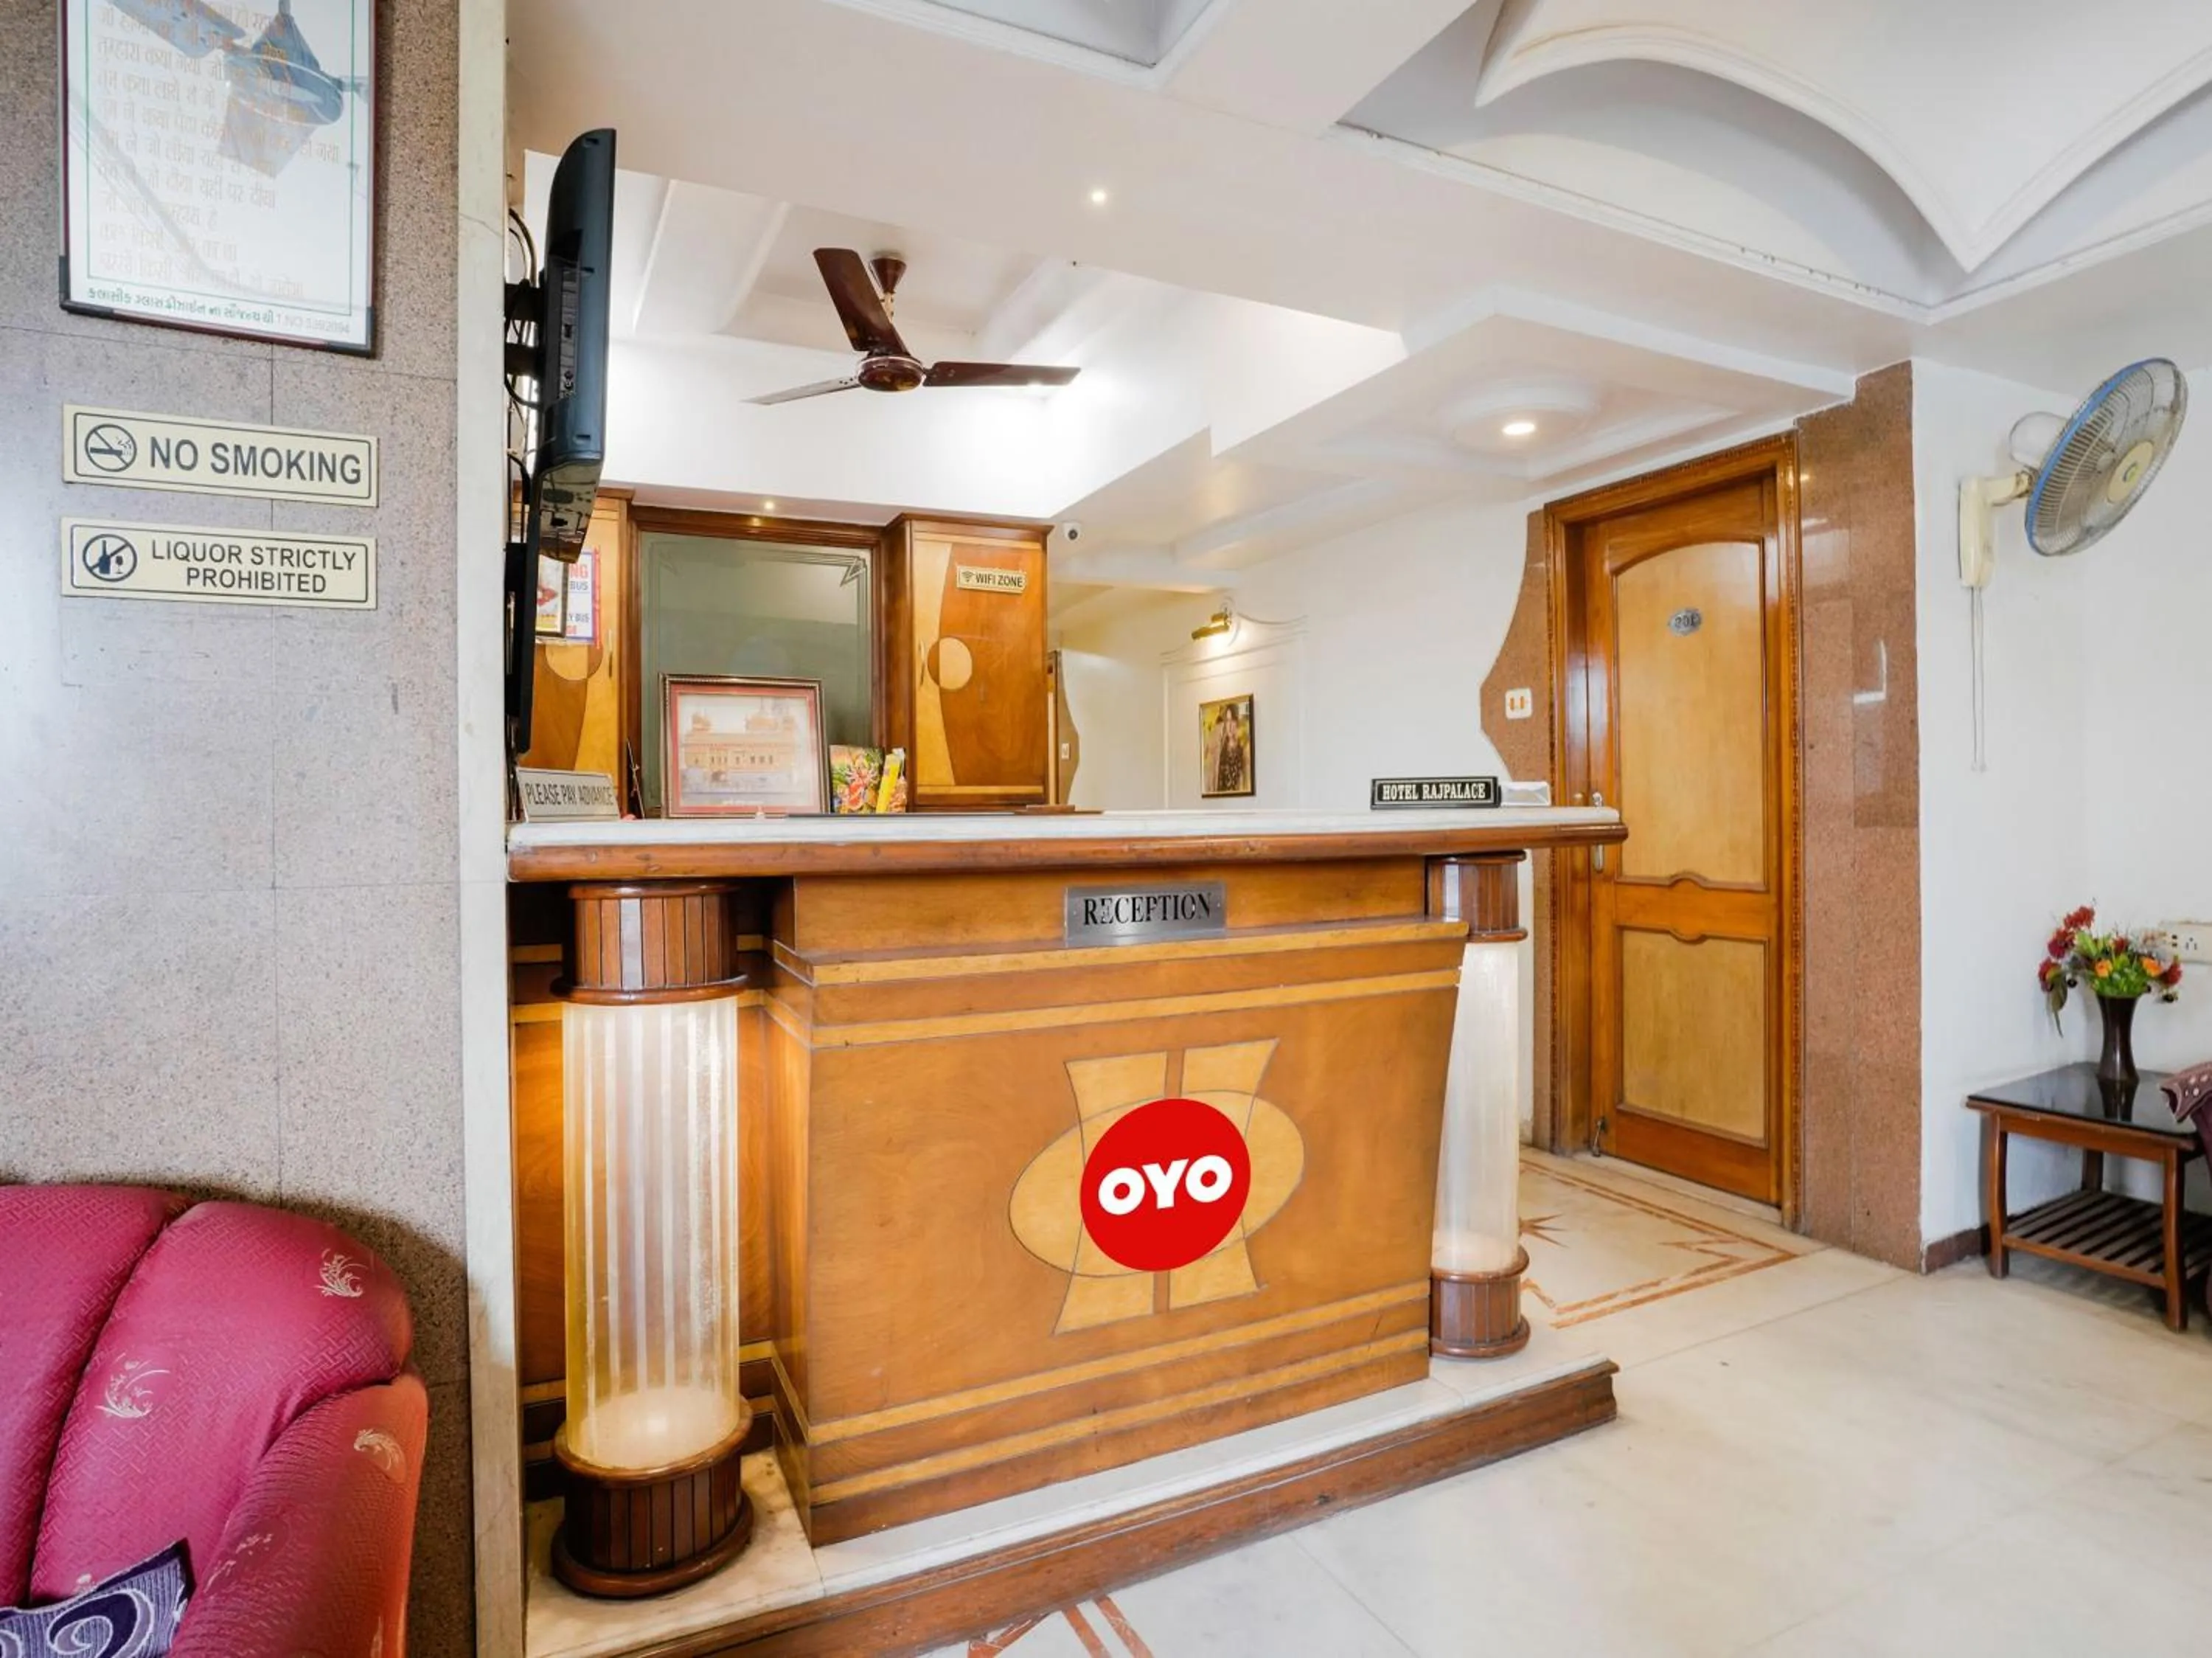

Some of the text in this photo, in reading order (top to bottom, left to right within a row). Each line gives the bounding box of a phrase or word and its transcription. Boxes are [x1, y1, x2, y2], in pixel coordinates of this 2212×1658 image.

[150, 437, 361, 485] NO SMOKING
[151, 540, 357, 571] LIQUOR STRICTLY
[187, 567, 327, 594] PROHIBITED
[975, 572, 1023, 588] WIFI ZONE
[525, 783, 613, 806] PLEASE PAY ADVANCE
[1382, 783, 1486, 800] HOTEL RAJPALACE
[1084, 892, 1211, 926] RECEPTION
[1098, 1154, 1233, 1215] OYO
